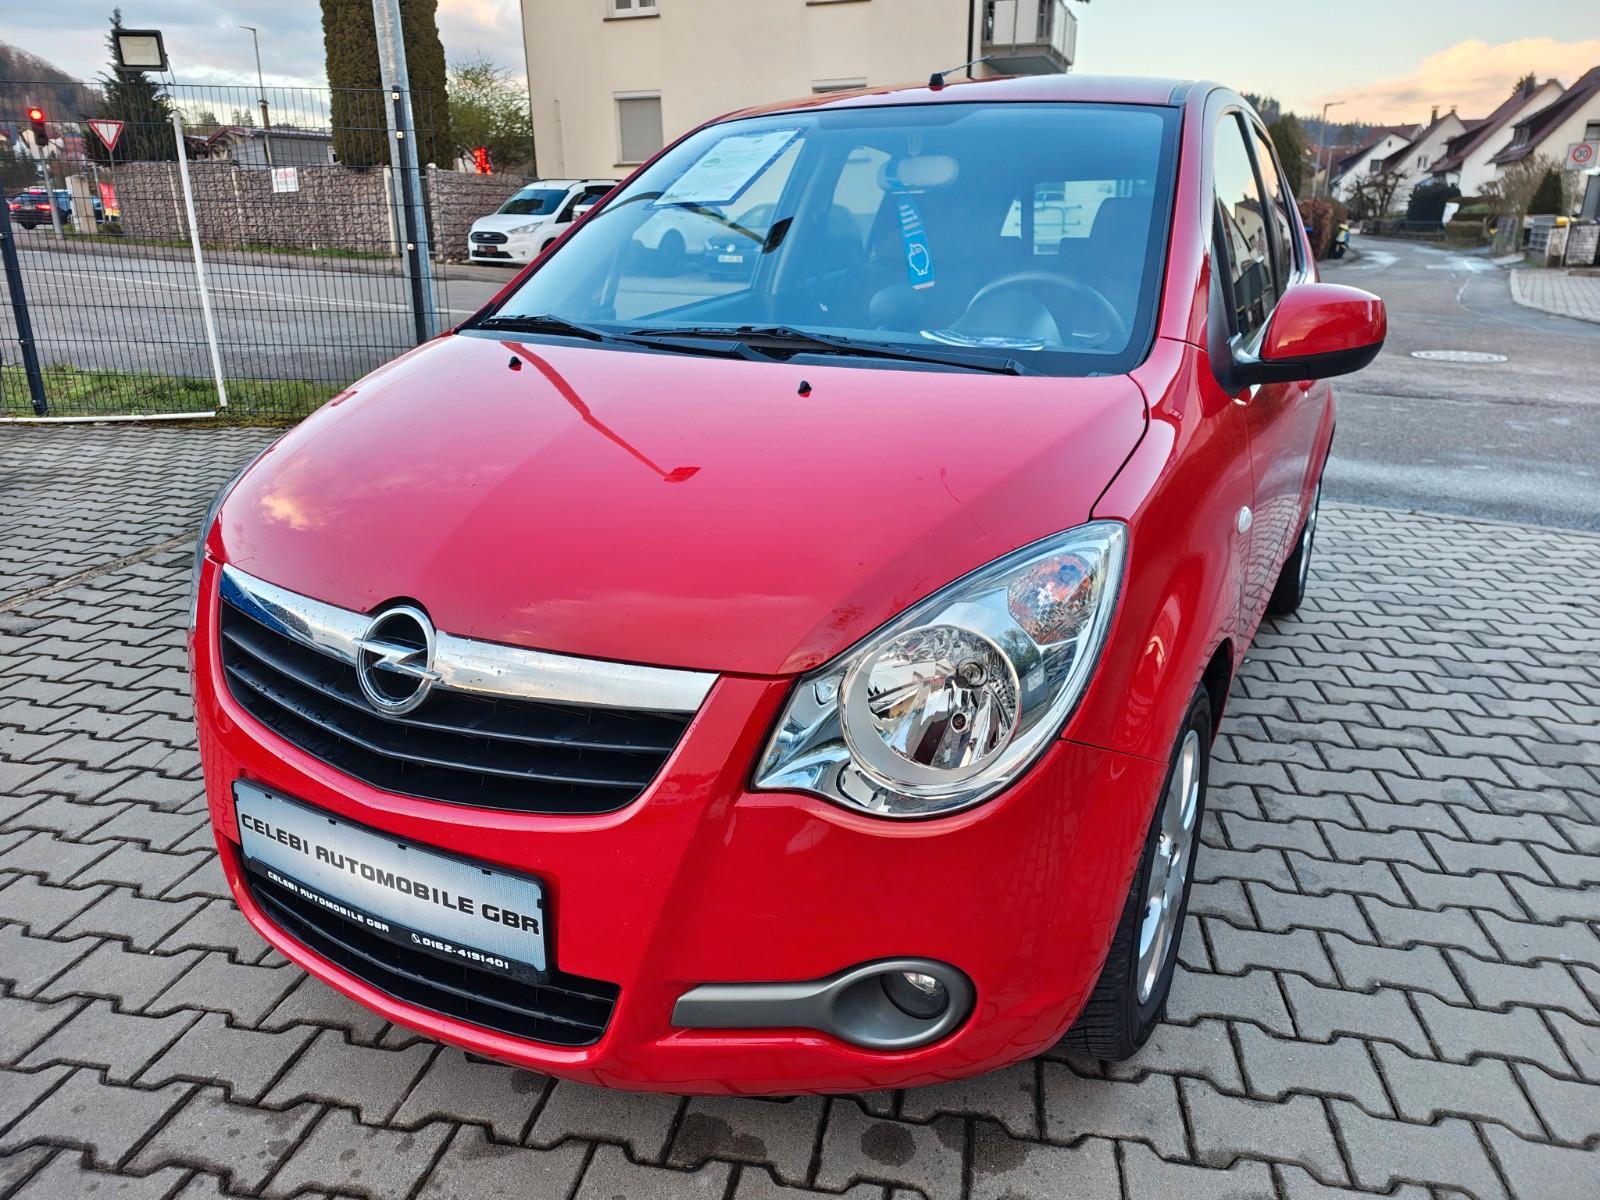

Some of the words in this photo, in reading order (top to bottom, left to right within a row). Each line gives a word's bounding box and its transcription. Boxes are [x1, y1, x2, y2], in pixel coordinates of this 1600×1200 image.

[1576, 149, 1588, 159] 30
[241, 813, 309, 855] CELEBI
[316, 845, 474, 915] AUTOMOBILE
[481, 903, 540, 936] GBR
[267, 870, 298, 892] CELEBI
[300, 888, 364, 923] AUTOMOBILE
[366, 918, 390, 933] GBR
[422, 937, 509, 969] 0162-4191401
